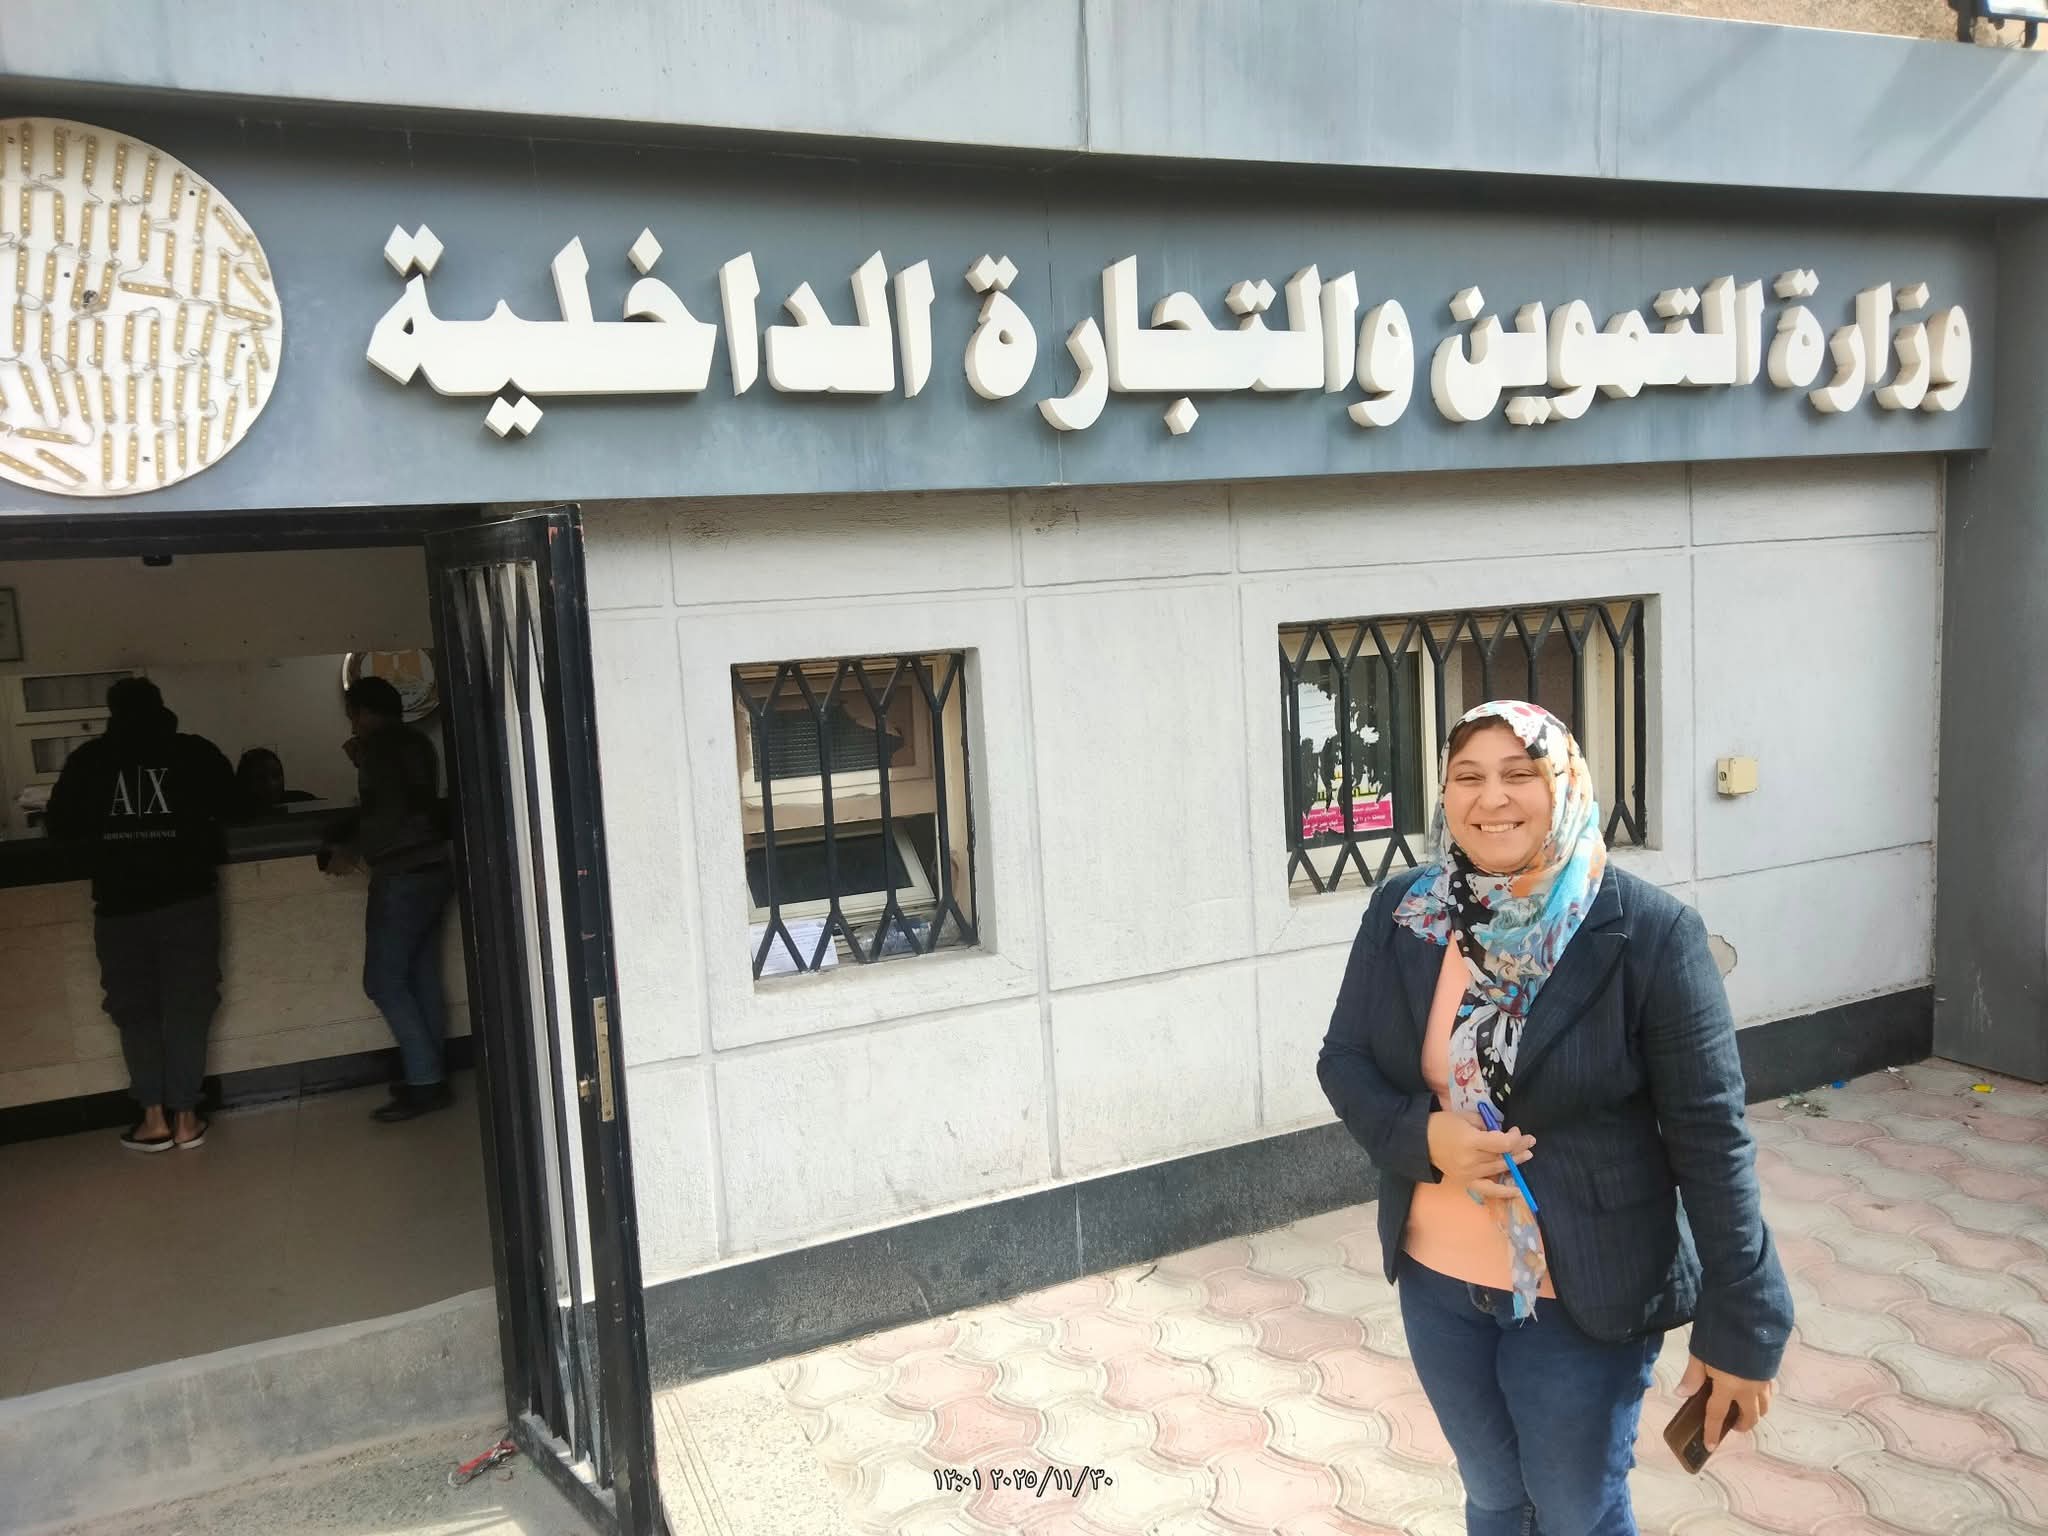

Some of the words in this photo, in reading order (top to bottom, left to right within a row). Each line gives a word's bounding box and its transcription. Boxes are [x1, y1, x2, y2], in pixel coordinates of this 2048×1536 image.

[365, 223, 937, 437] الداخلية
[964, 253, 1416, 435] والتجارة
[1431, 273, 1767, 426] التموين
[1767, 268, 1972, 414] وزارة
